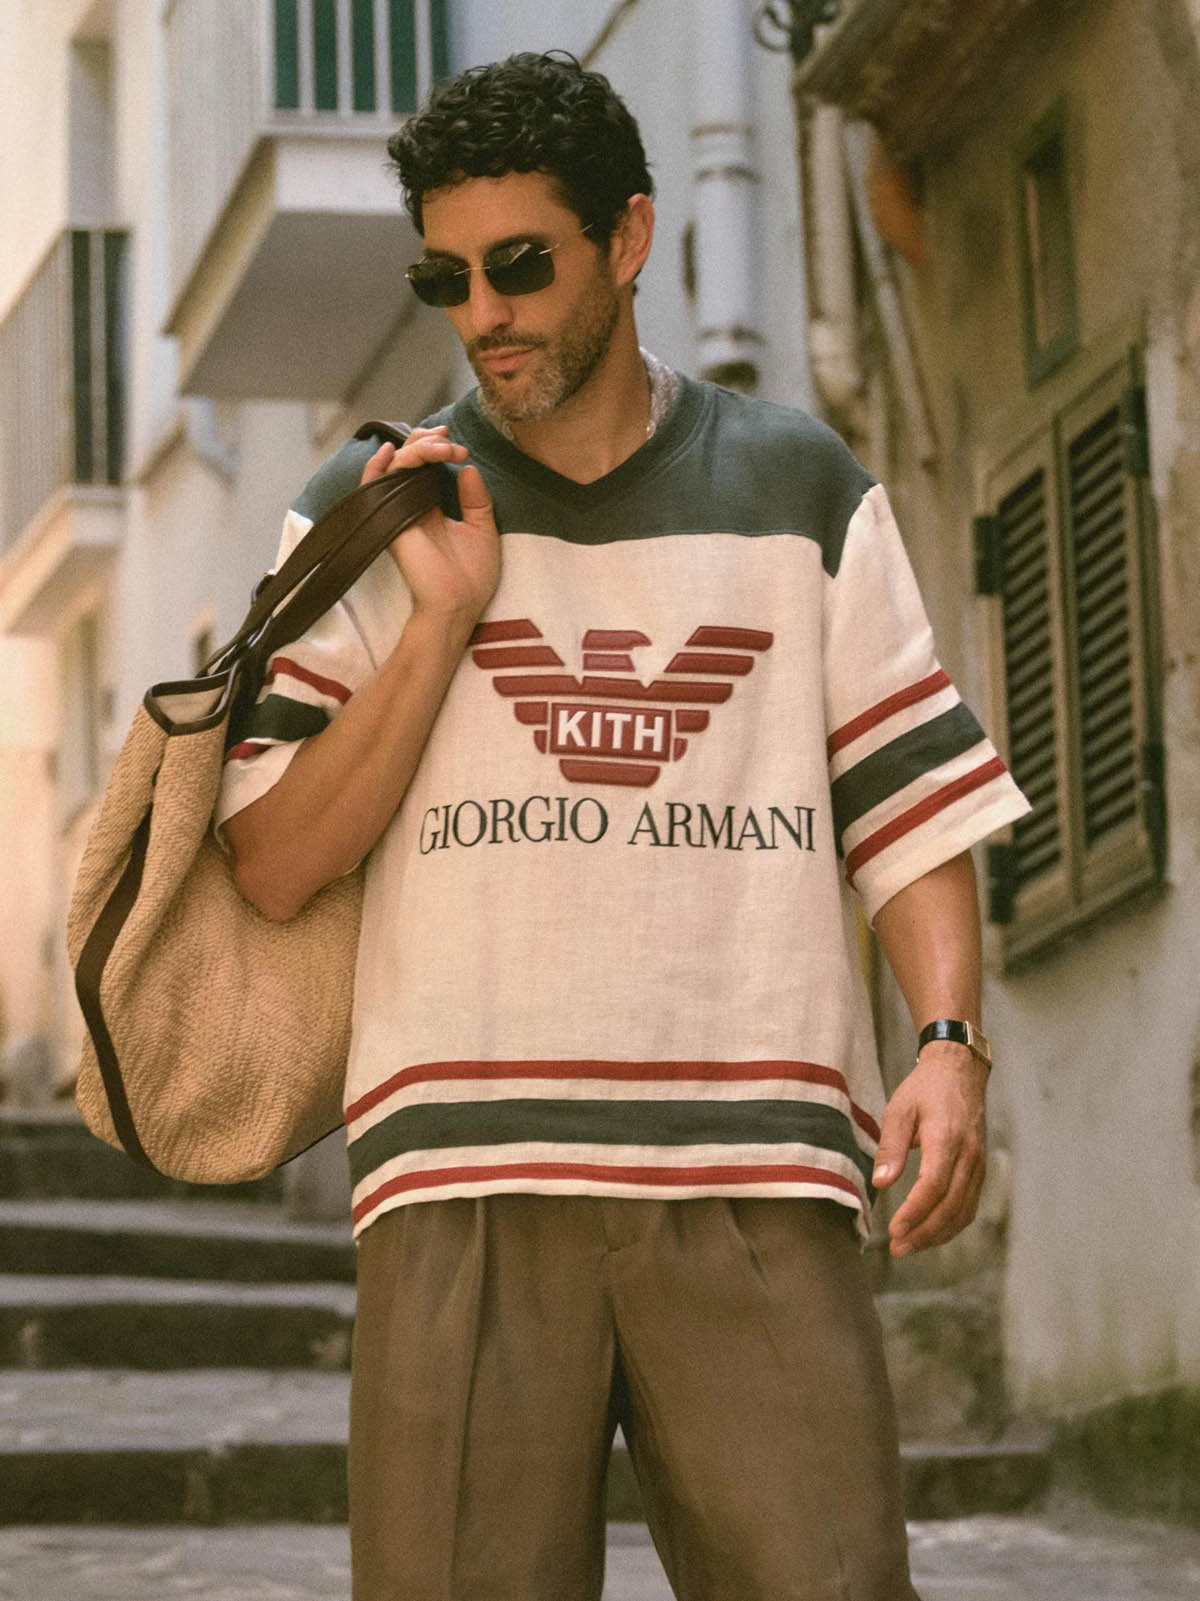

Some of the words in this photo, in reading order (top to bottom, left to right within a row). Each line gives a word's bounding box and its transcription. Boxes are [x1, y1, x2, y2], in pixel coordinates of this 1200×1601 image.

[557, 710, 664, 752] KITH
[419, 796, 608, 854] GIORGIO
[627, 801, 816, 851] ARMANI
